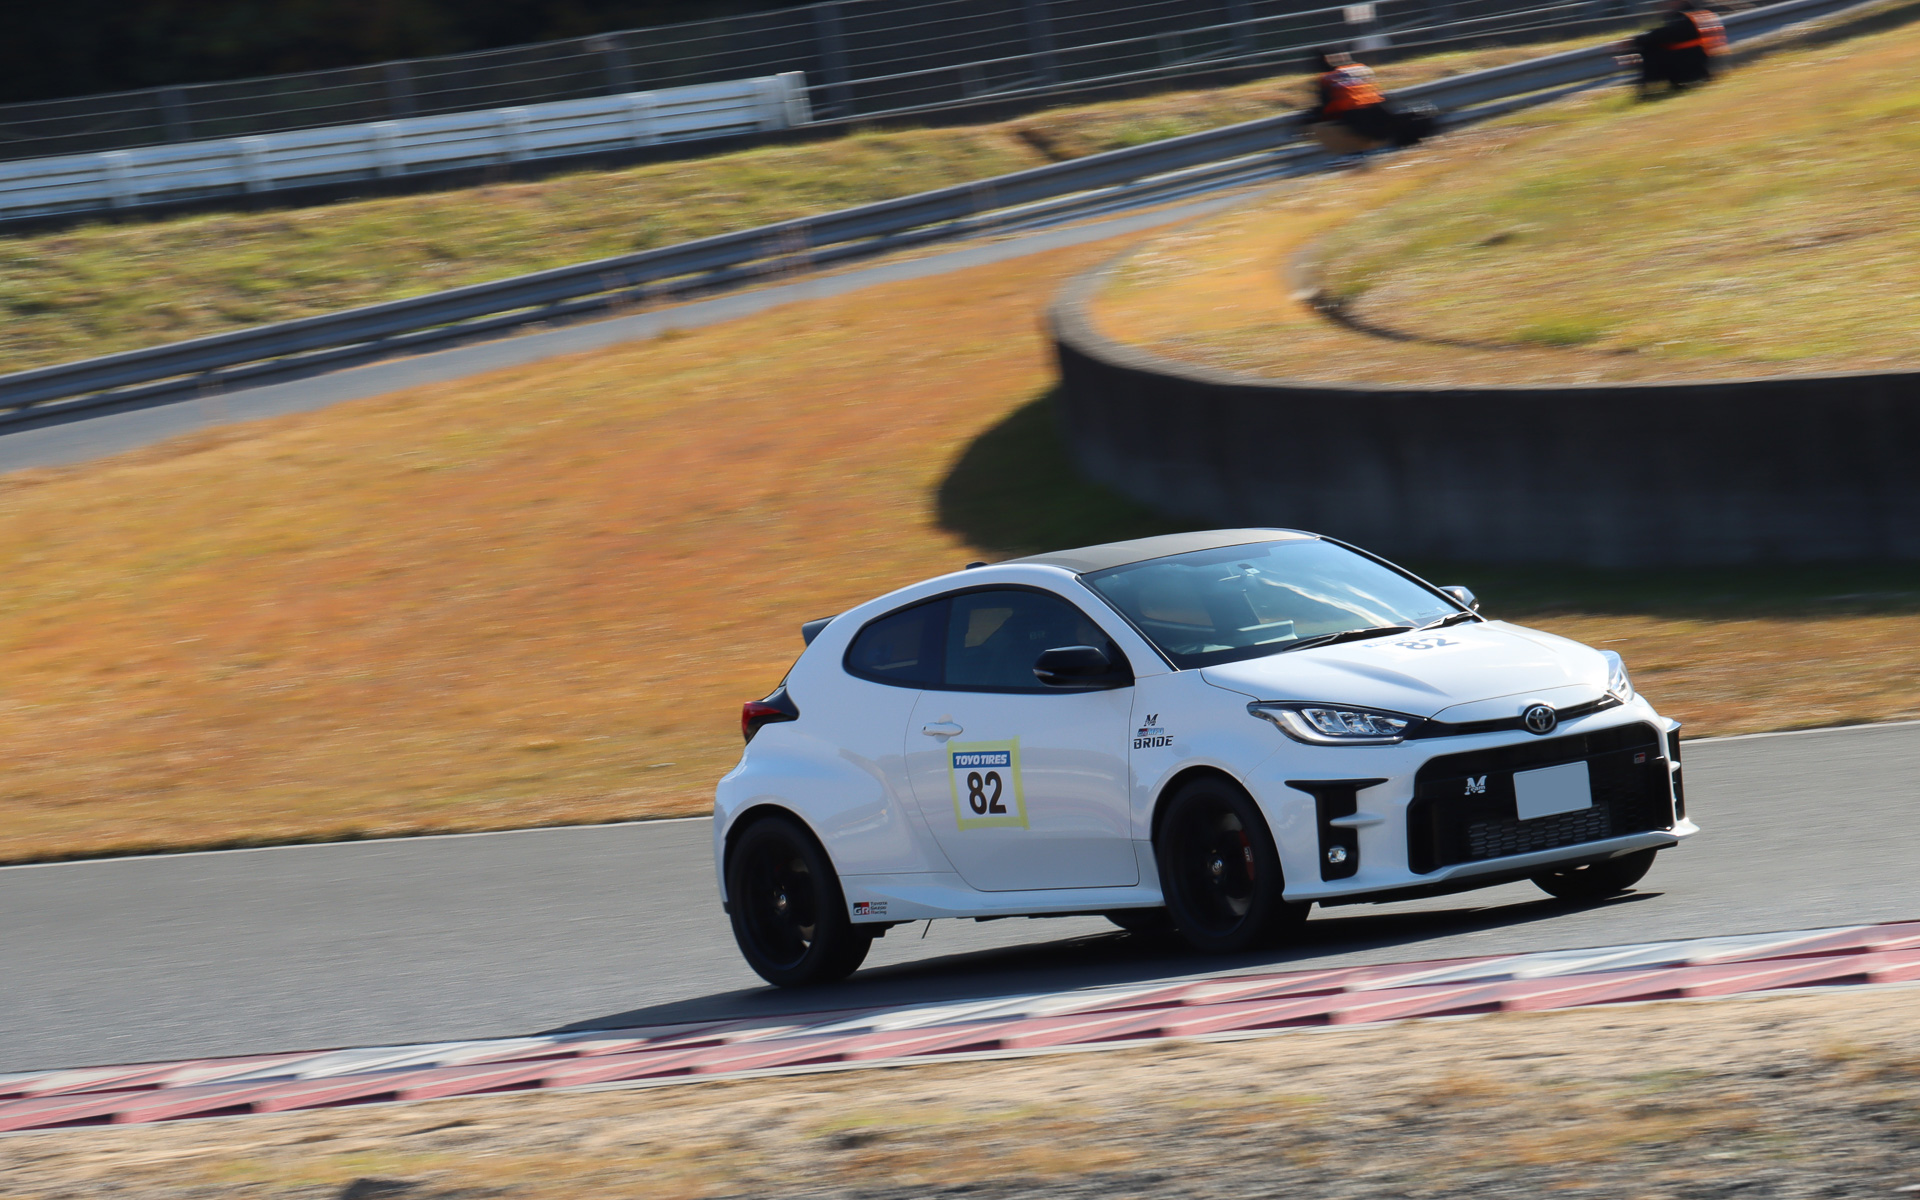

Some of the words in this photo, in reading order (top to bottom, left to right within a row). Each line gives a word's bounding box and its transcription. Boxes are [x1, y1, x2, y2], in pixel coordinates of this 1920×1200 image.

[1394, 637, 1461, 650] 82
[1133, 735, 1174, 750] BRIDE
[955, 755, 980, 766] TOYO
[980, 754, 1008, 765] TIRES
[967, 770, 1007, 815] 82
[854, 907, 870, 915] GR
